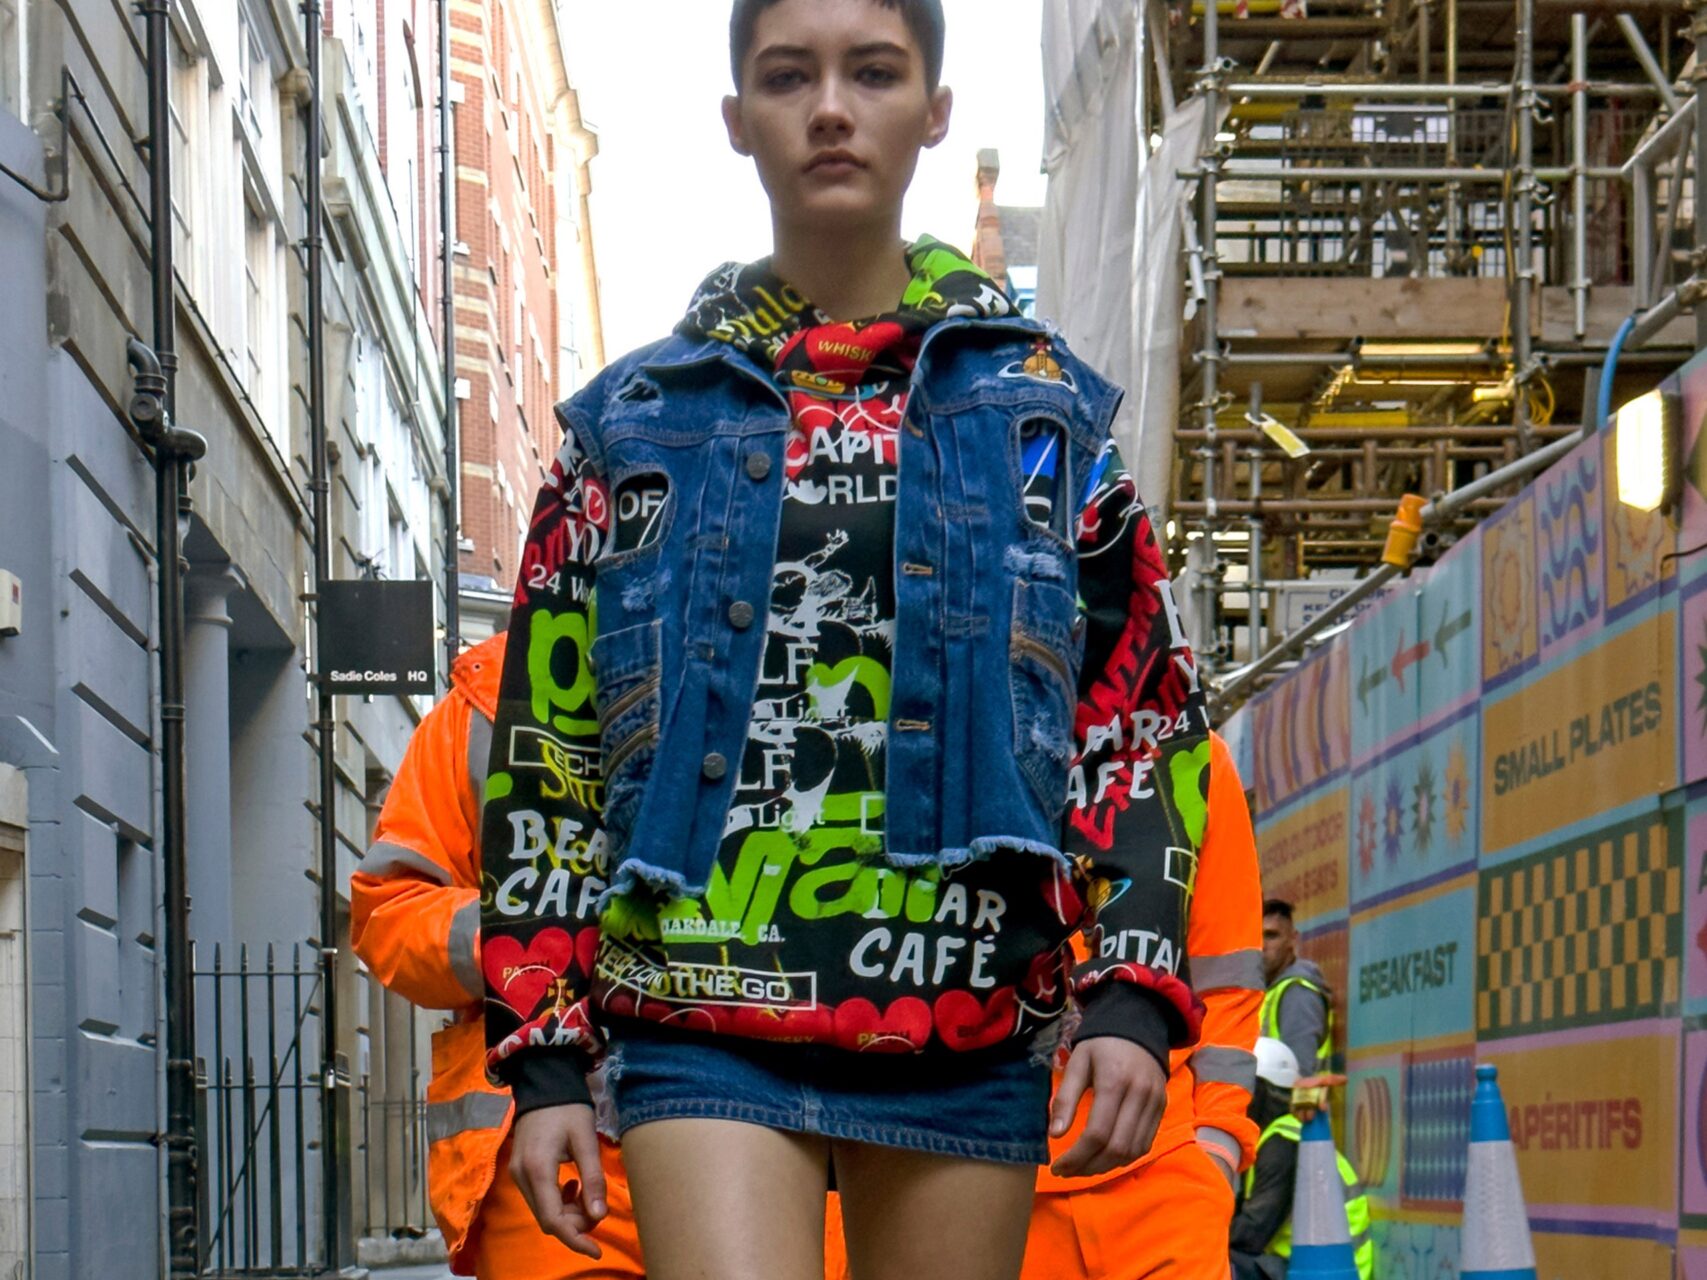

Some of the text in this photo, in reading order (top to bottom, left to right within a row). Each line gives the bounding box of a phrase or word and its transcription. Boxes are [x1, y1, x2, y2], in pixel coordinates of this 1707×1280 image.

[619, 489, 664, 520] OF
[528, 564, 561, 595] 24
[330, 670, 428, 681] Sadie Coles HQ
[1157, 710, 1191, 740] 24
[1494, 681, 1662, 796] SMALL PLATES
[850, 927, 997, 989] CAFÉ
[1359, 941, 1457, 1004] BREAKFAST
[741, 977, 790, 1001] GO
[1508, 1092, 1642, 1151] APÉRITIFS
